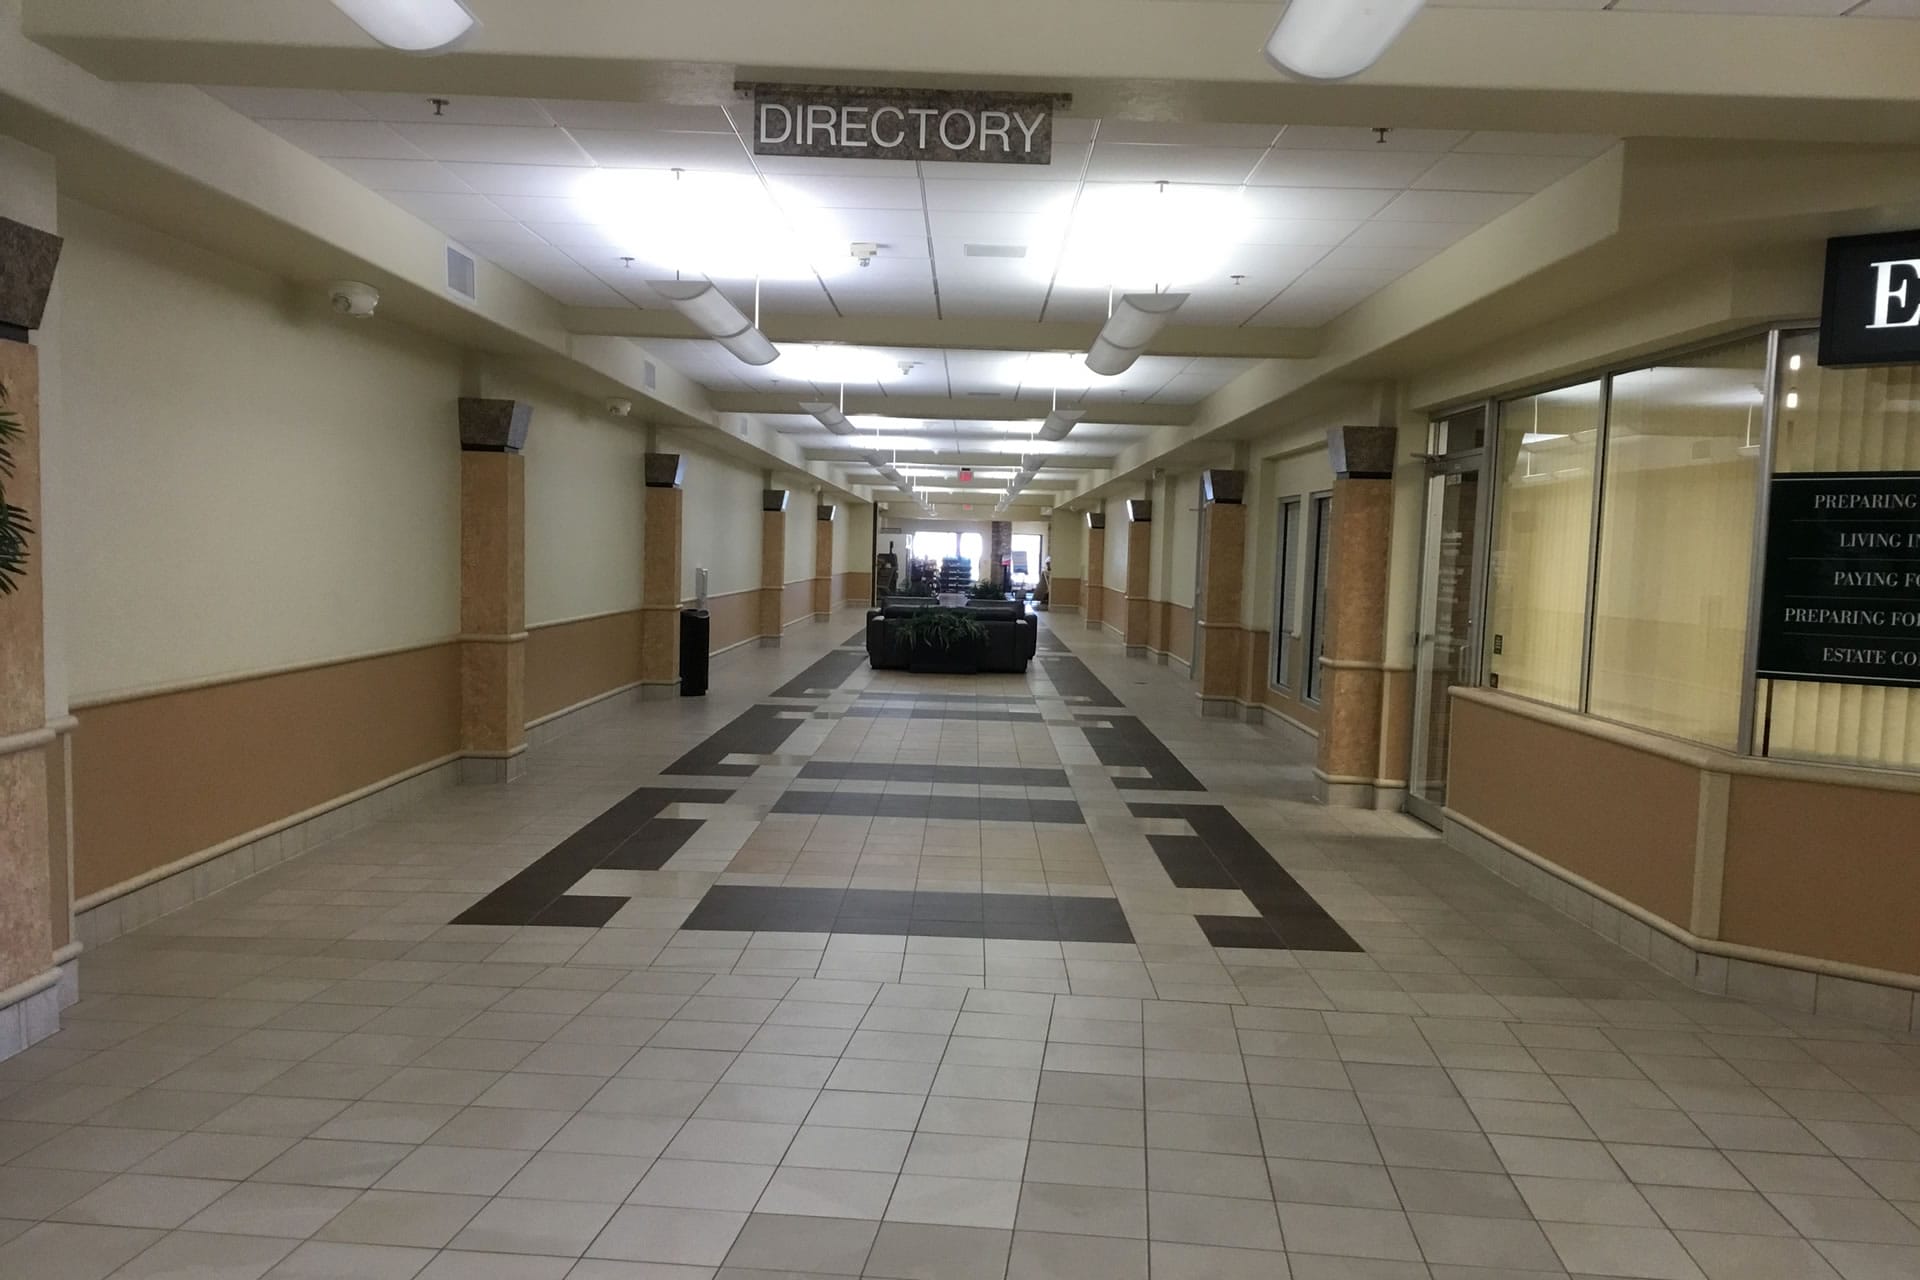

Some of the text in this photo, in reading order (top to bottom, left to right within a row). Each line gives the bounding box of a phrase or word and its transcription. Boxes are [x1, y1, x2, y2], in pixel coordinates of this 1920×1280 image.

[759, 103, 1046, 153] DIRECTORY
[1865, 258, 1920, 329] E
[1814, 494, 1917, 509] PREPARING
[1840, 532, 1901, 548] LIVING
[1833, 571, 1898, 587] PAYING
[1784, 607, 1885, 625] PREPARING
[1823, 647, 1920, 666] ESTATE CO
